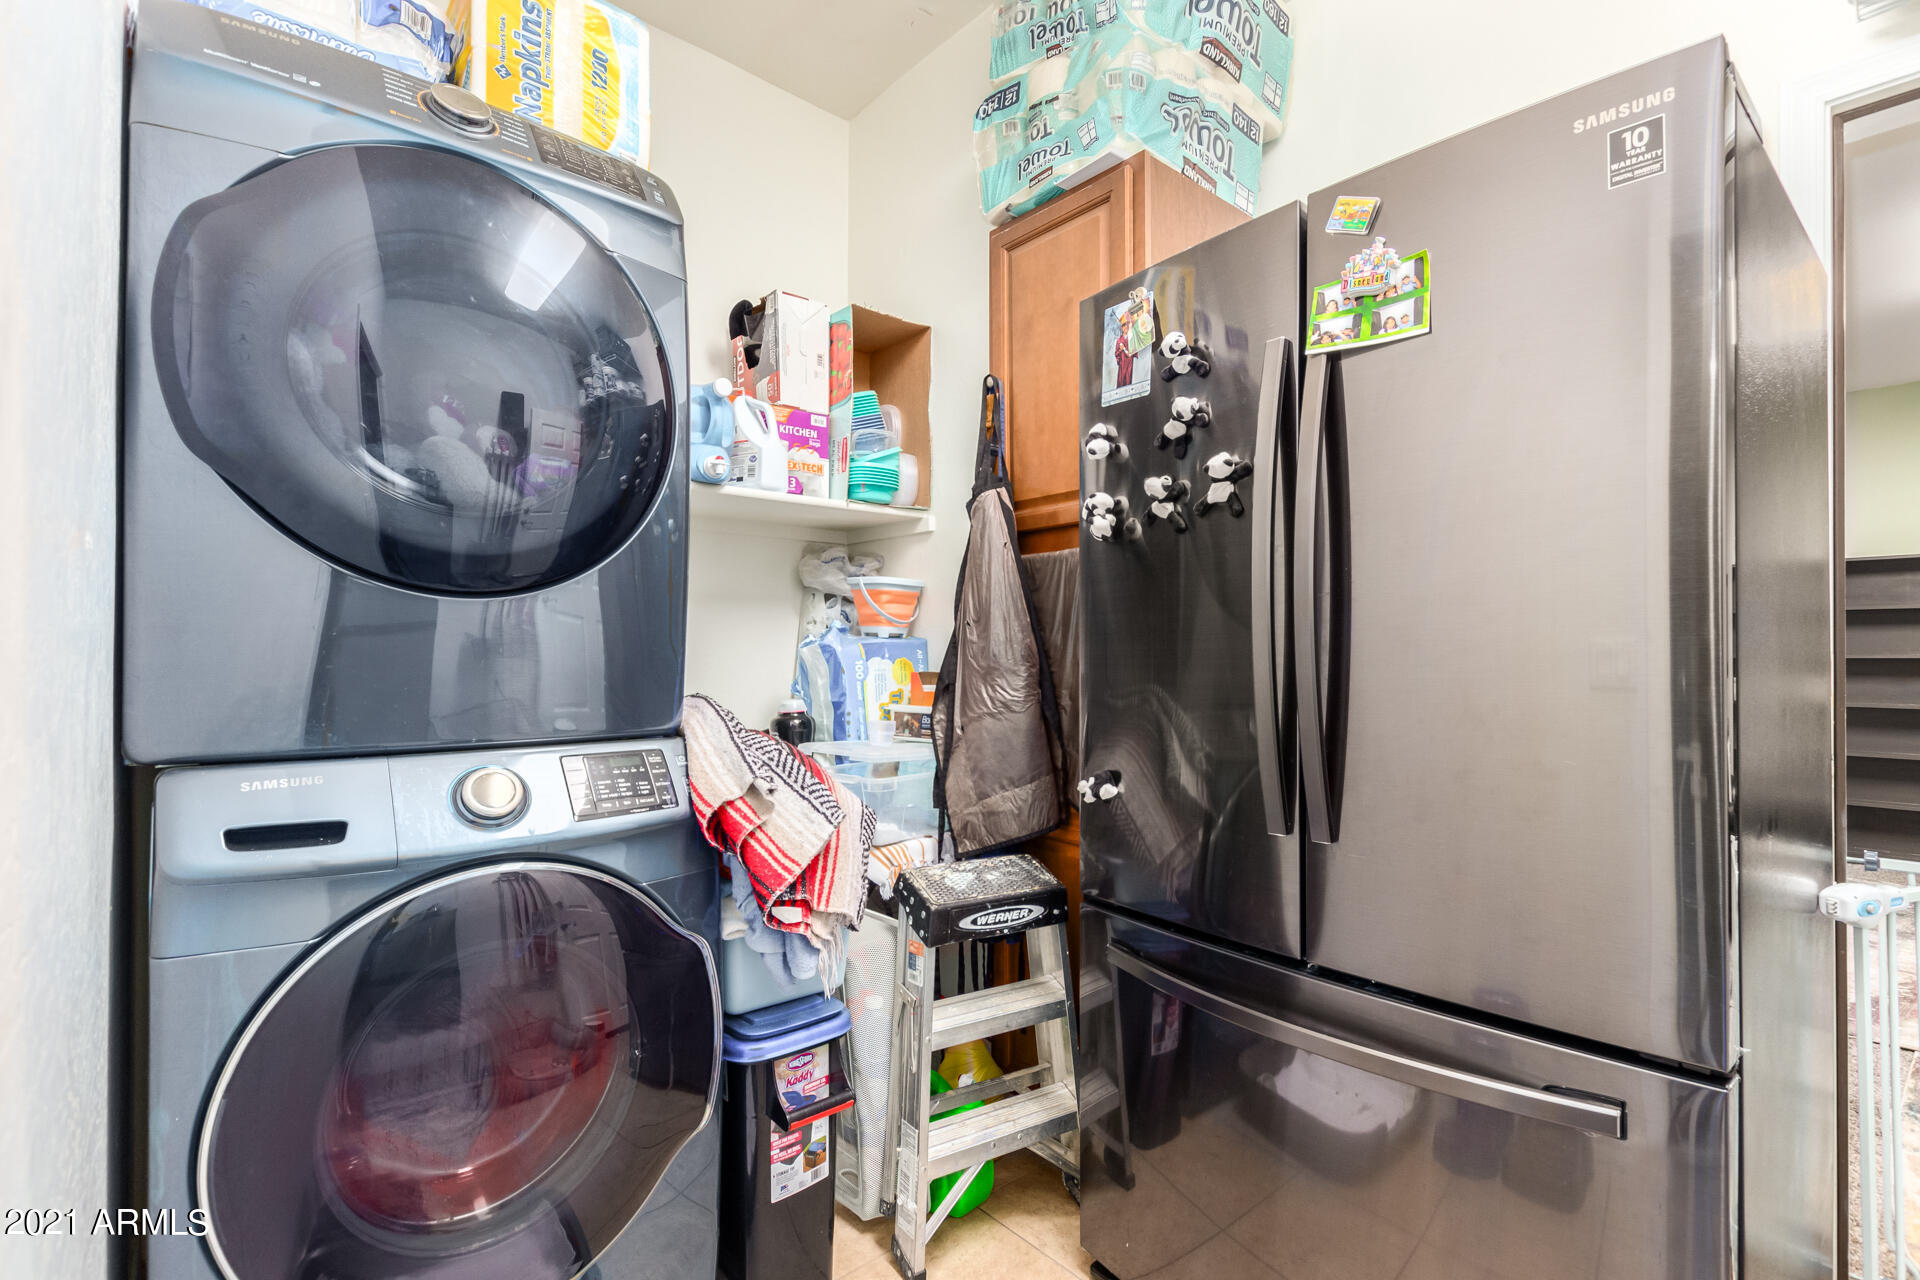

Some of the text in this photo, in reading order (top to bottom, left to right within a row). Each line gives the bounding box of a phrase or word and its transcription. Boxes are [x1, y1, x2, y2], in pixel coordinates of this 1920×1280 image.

[1029, 8, 1089, 51] Towel
[1184, 0, 1262, 69] Towel
[1280, 17, 1288, 33] 12
[1203, 17, 1246, 58] PREMIUM
[513, 0, 550, 124] Napkins
[591, 47, 609, 91] 1200
[1203, 43, 1241, 80] KIRKLAND
[979, 97, 999, 118] 140
[1006, 91, 1017, 104] 12
[1572, 86, 1676, 134] SAMSUNG
[1233, 112, 1248, 132] 140
[1250, 127, 1259, 145] 12
[1621, 126, 1650, 152] 10
[1018, 137, 1074, 182] Towel
[1182, 141, 1219, 174] PREMIUM
[1610, 149, 1662, 171] WARRANTY
[1626, 146, 1647, 157] YEAR
[1028, 157, 1057, 176] PREMIUM
[1342, 269, 1391, 292] Disneyland
[779, 424, 818, 439] KITCHEN
[855, 660, 865, 680] 100
[239, 775, 325, 793] SAMSUNG
[976, 908, 1030, 926] WERNER
[785, 1068, 815, 1089] Kaddy
